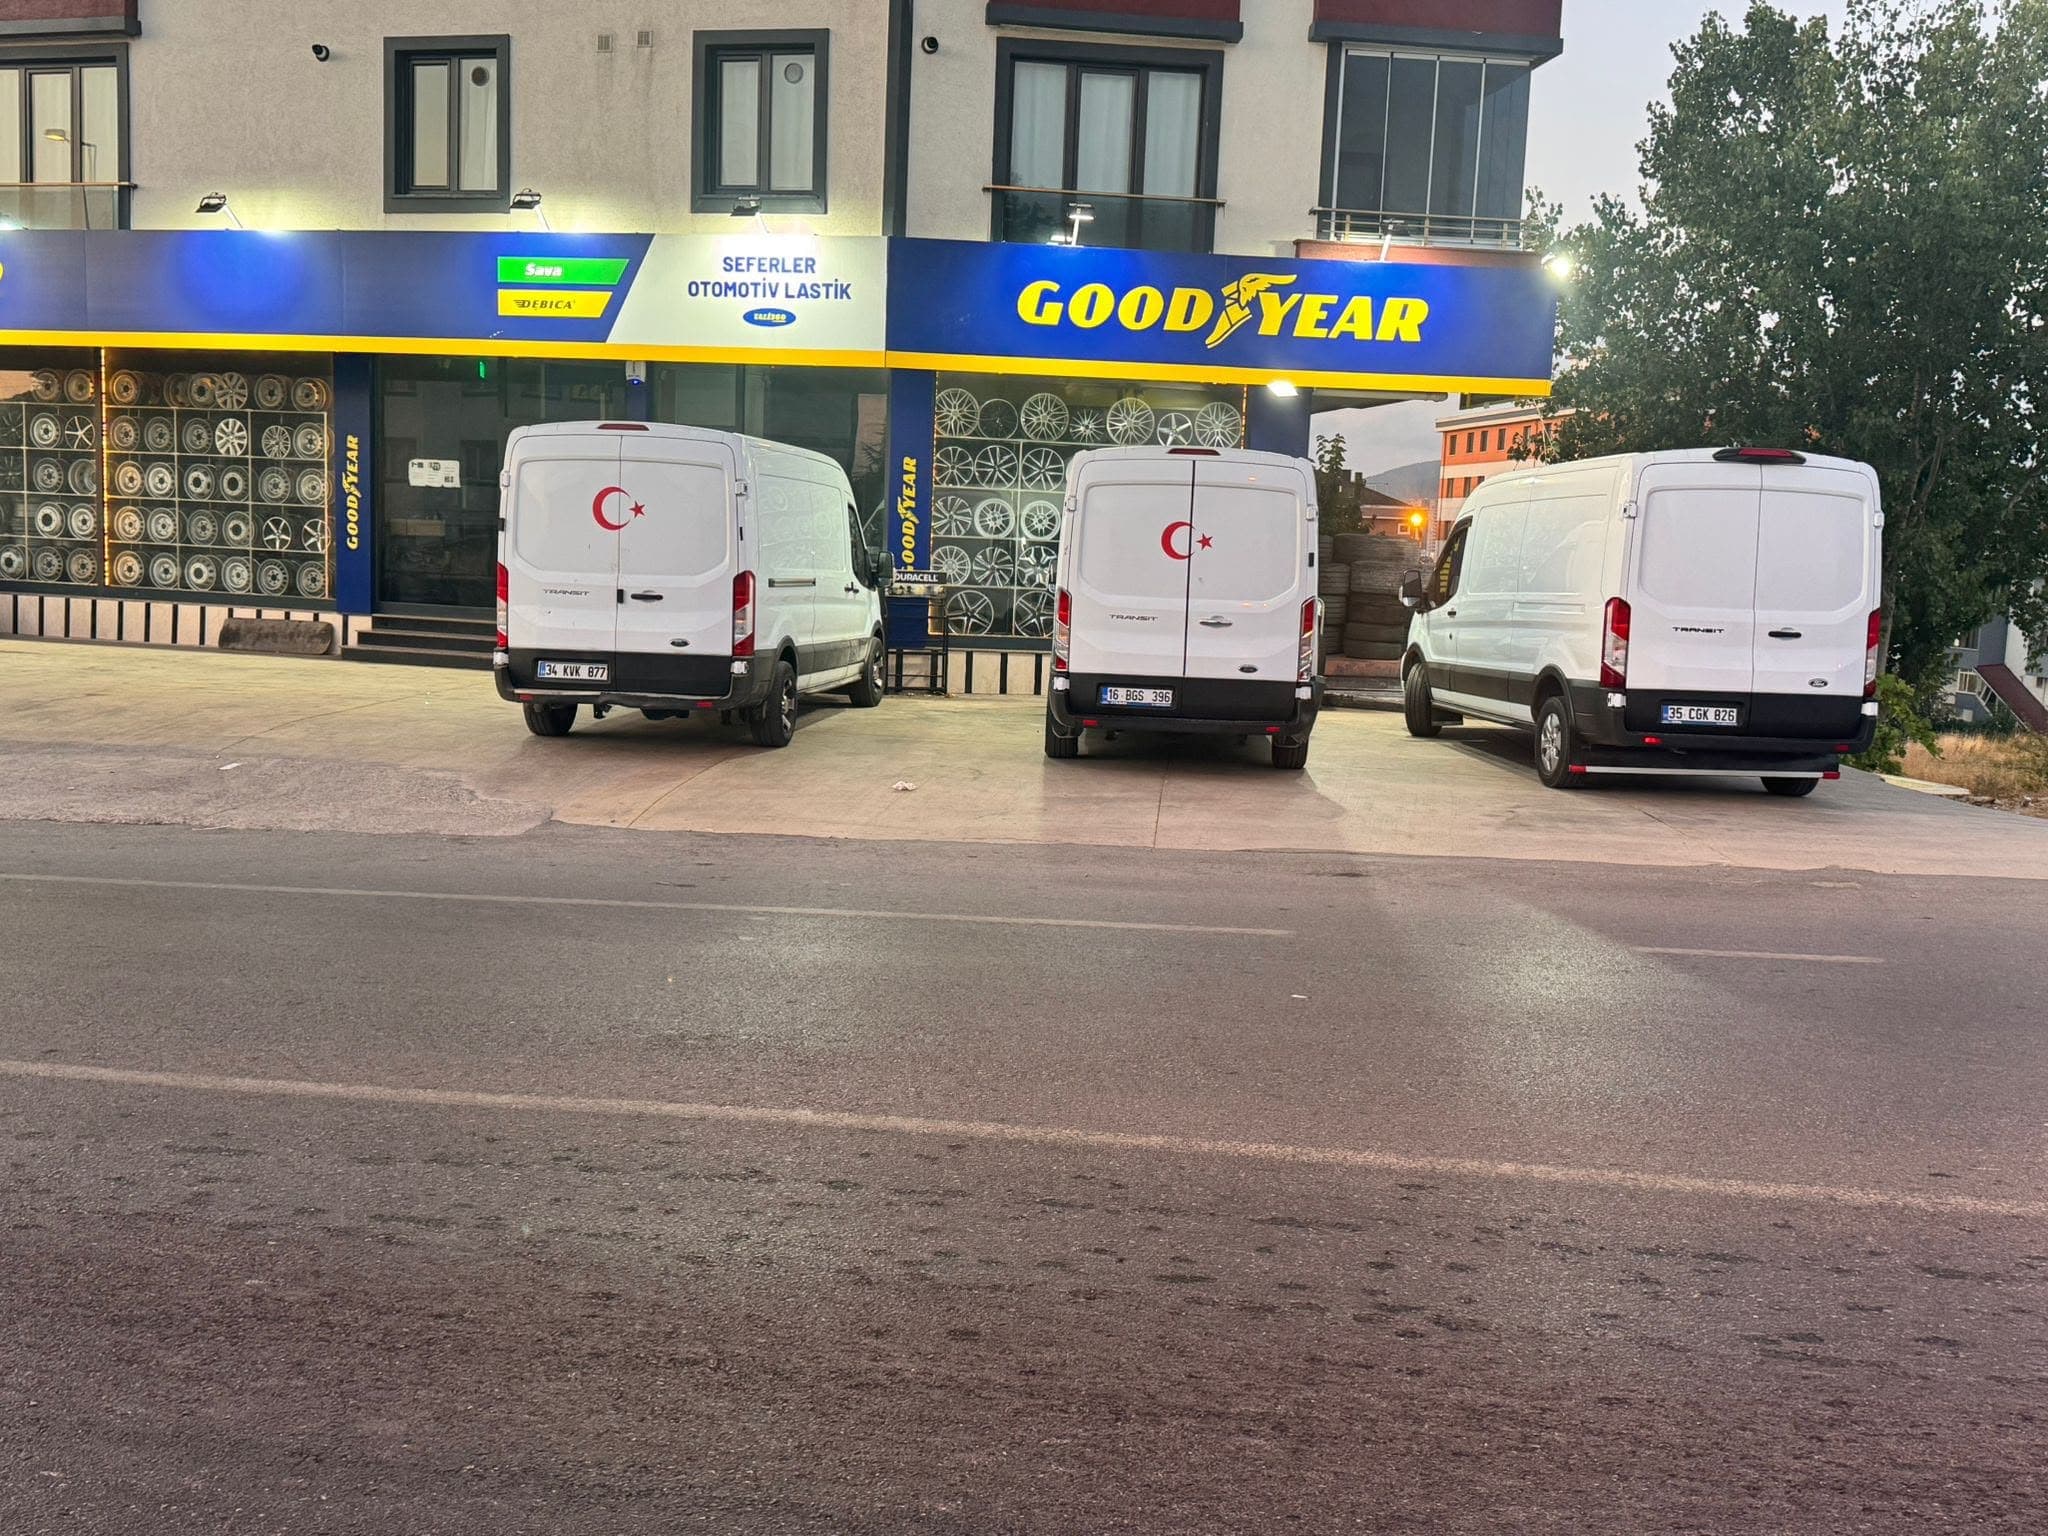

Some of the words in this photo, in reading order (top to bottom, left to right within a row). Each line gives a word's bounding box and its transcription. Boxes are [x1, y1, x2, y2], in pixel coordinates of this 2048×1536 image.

[525, 262, 563, 276] Sava
[722, 256, 816, 273] SEFERLER
[687, 277, 779, 298] OTOMOTİV
[784, 278, 852, 300] LASTİK
[1016, 277, 1430, 345] GOODYEAR
[344, 434, 361, 550] GOODYEAR
[543, 588, 590, 596] TRANSIT
[1108, 613, 1159, 621] TRANSIT
[545, 664, 558, 676] 34
[563, 664, 582, 677] KVK
[587, 666, 606, 678] 877
[1108, 688, 1119, 700] 16
[1125, 689, 1145, 701] BGS
[1151, 691, 1171, 703] 396
[1669, 707, 1683, 719] 35
[1688, 708, 1709, 720] CGK
[1714, 709, 1735, 721] 826
